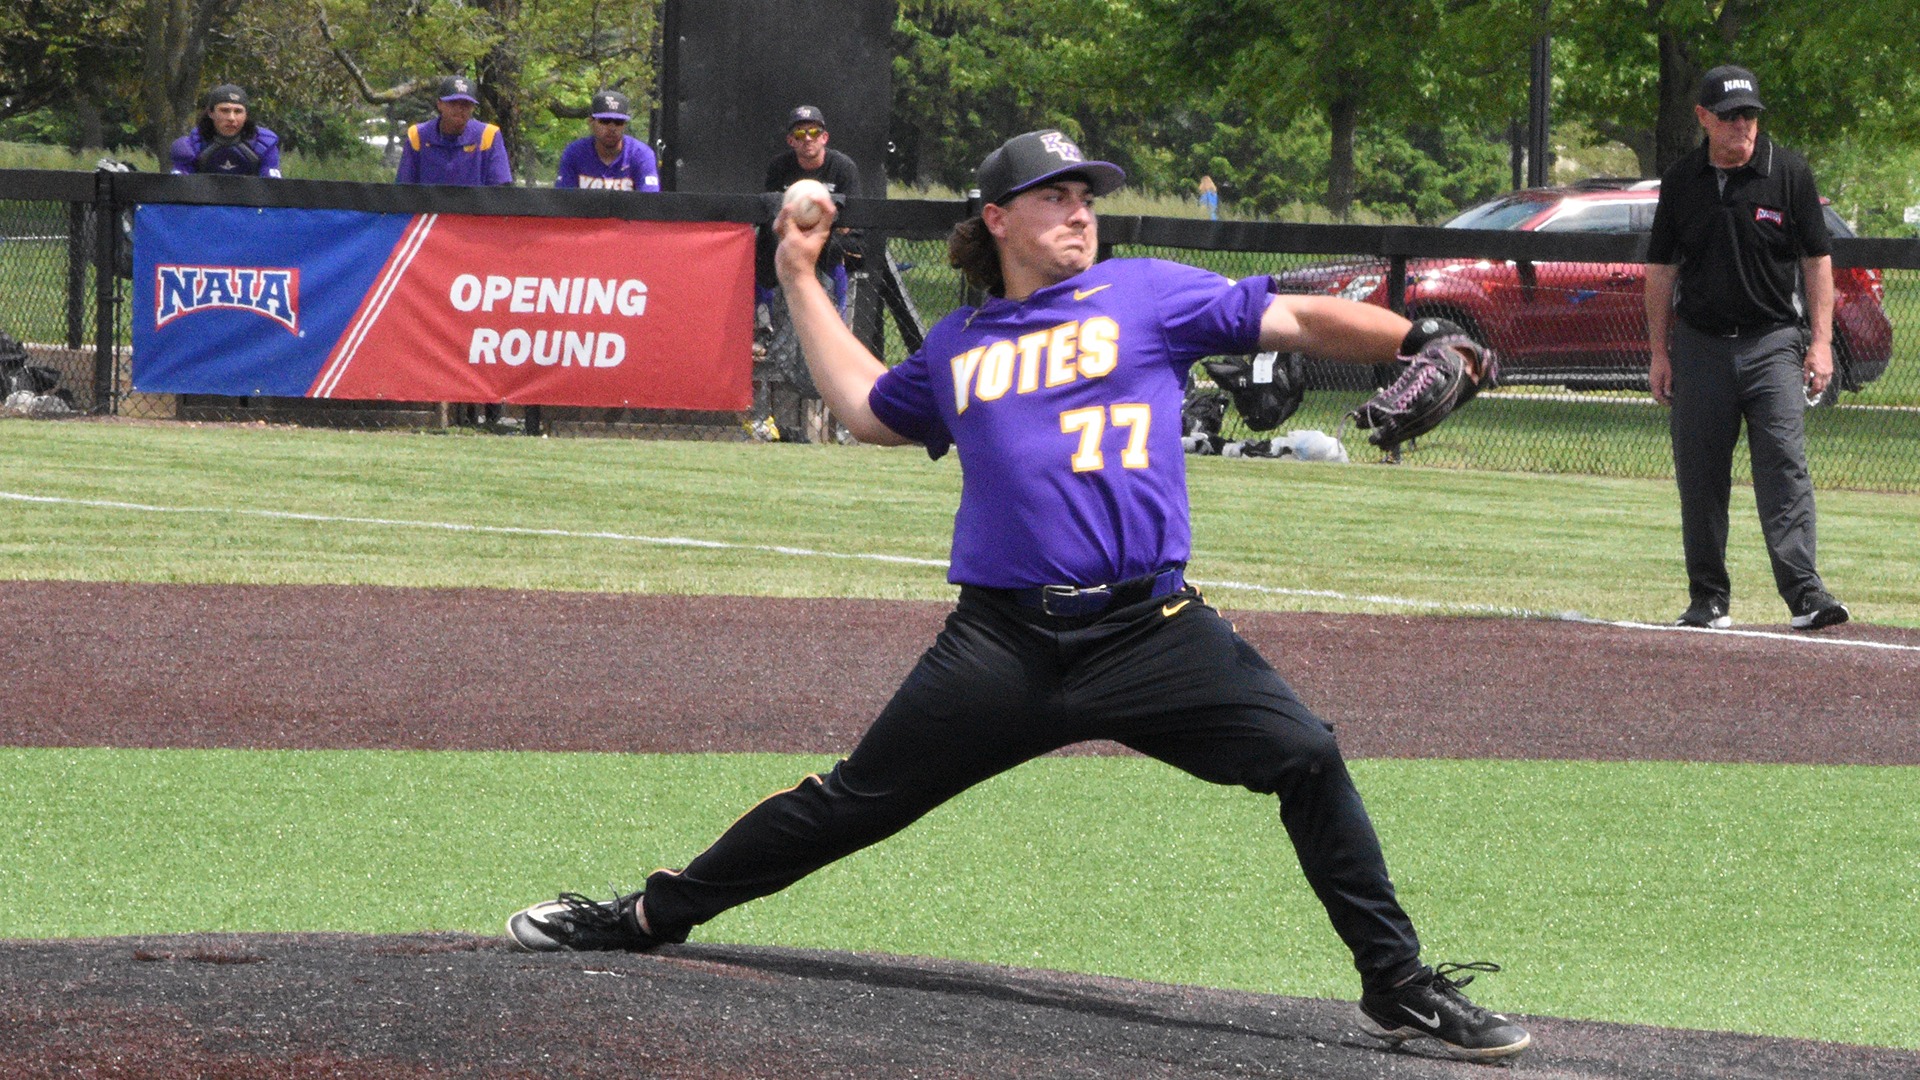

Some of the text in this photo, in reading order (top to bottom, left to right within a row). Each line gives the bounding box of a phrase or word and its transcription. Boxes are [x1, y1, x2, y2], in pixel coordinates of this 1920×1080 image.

[1723, 79, 1753, 93] NAIA
[156, 265, 298, 331] NAIA
[449, 274, 648, 317] OPENING
[468, 327, 627, 369] ROUND
[950, 315, 1120, 415] YOTES
[1059, 402, 1152, 473] 77
